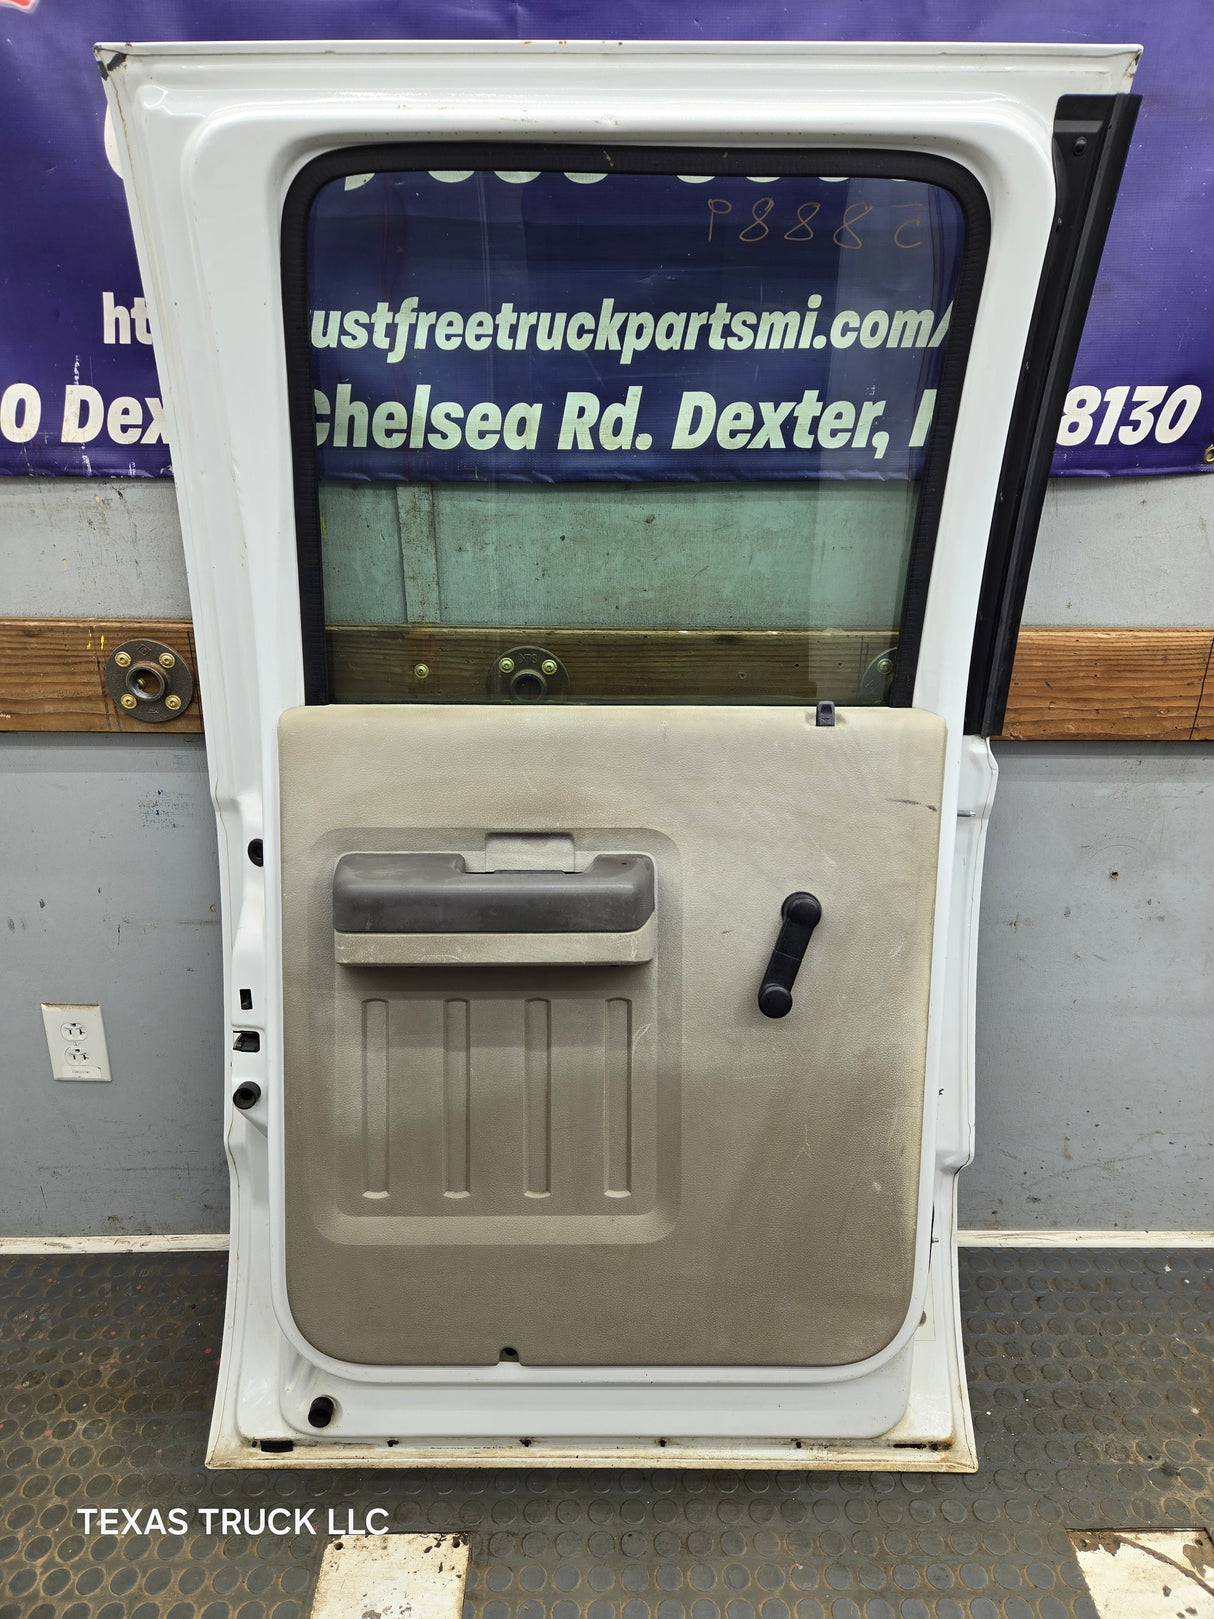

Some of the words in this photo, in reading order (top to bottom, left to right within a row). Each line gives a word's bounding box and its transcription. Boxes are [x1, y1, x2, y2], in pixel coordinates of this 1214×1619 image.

[556, 385, 654, 451] Rd.
[671, 389, 891, 460] Dexter,
[1056, 384, 1203, 447] 8130
